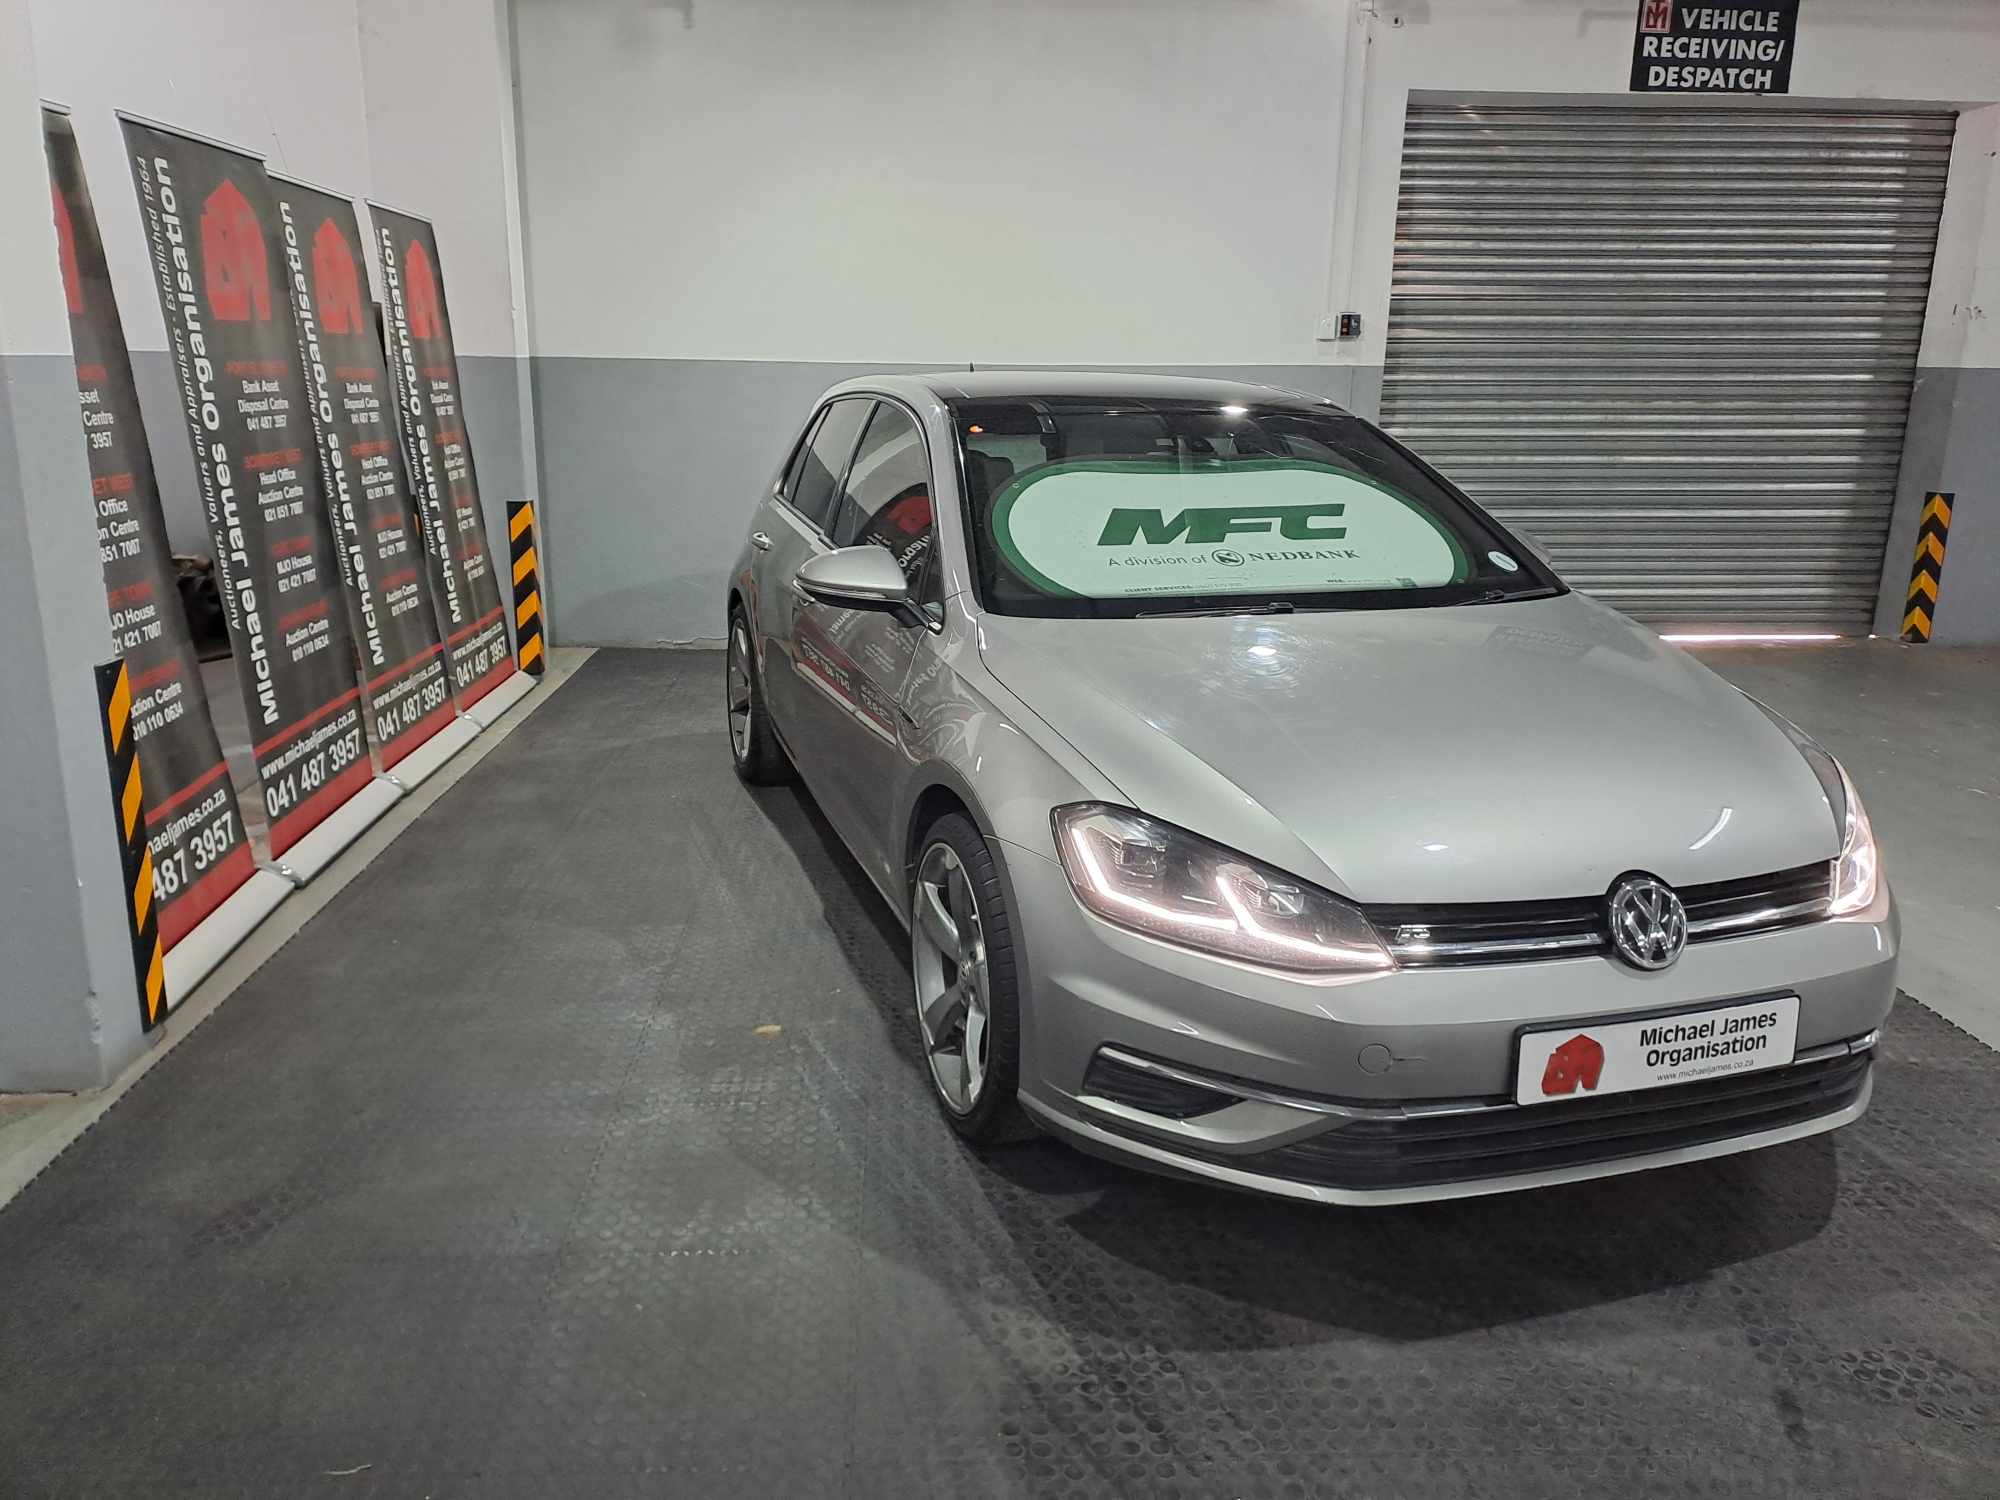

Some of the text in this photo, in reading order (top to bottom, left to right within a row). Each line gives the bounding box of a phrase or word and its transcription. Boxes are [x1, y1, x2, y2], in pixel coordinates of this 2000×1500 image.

[1681, 8, 1781, 32] VEHICLE
[1642, 36, 1785, 62] RECEIVING/
[1648, 66, 1773, 90] DESPATCH
[136, 156, 155, 202] 1964
[147, 207, 177, 311] Established
[280, 201, 333, 424] Organisation
[381, 227, 422, 417] Organisation
[173, 327, 199, 420] Appraisers
[79, 388, 100, 404] sset
[83, 410, 114, 427] Centre
[312, 416, 323, 444] and
[91, 431, 113, 449] 3957
[154, 156, 280, 726] Michael James Organisation
[191, 424, 206, 457] and
[327, 432, 358, 536] James
[416, 424, 441, 513] James
[99, 498, 129, 517] Office
[200, 461, 219, 523] Valuers
[110, 518, 140, 538] Centre
[1097, 503, 1347, 546] MFC
[1108, 549, 1361, 568] A division of NEDBANK
[125, 604, 156, 624] House
[112, 636, 124, 654] 21
[124, 629, 142, 648] 421
[456, 659, 475, 688] 041
[154, 681, 182, 705] Centre
[377, 676, 446, 741] 041 487 3957
[261, 708, 357, 780] www.michaeljames.co.za
[266, 727, 360, 818] 041 487 3957
[153, 810, 235, 901] 487 3957
[1639, 1010, 1778, 1047] Michael James
[1645, 1032, 1768, 1068] Organisation
[1656, 1058, 1754, 1081] www.michaeljames.co.za
